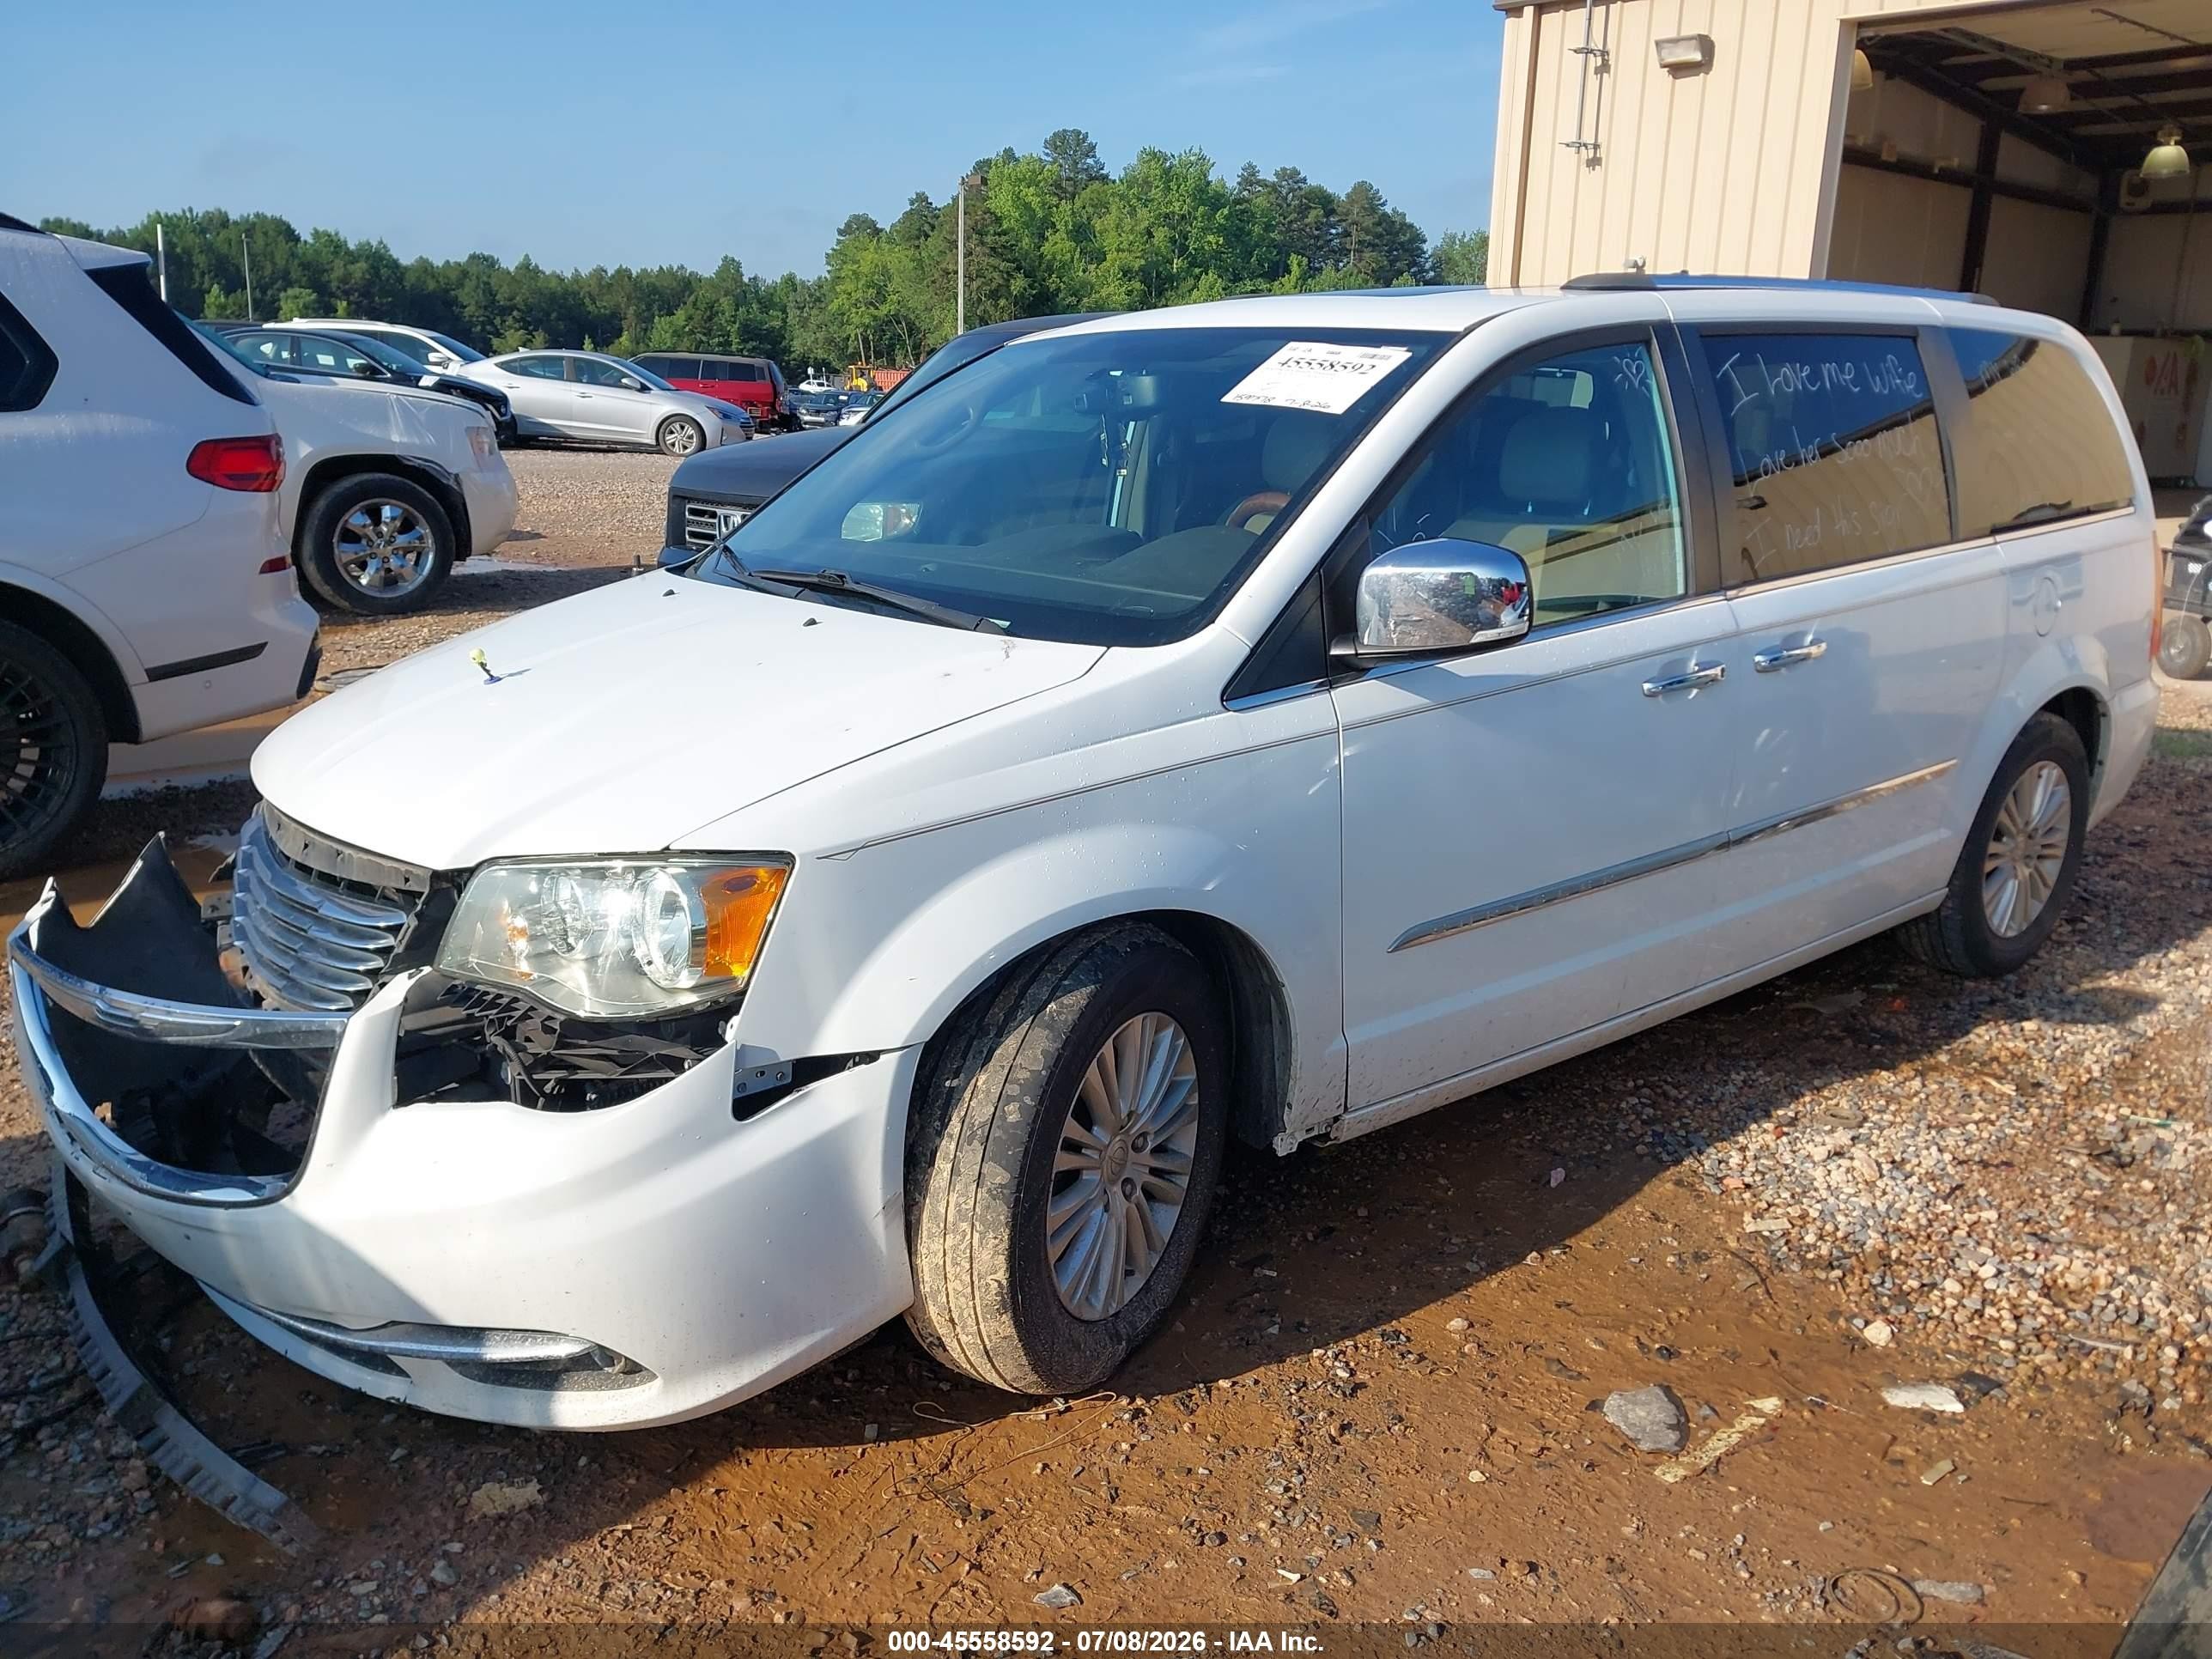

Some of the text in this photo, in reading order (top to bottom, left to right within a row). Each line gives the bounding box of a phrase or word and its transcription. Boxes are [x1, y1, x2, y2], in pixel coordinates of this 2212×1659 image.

[1278, 356, 1376, 374] 45558592
[1716, 352, 1759, 416] I
[1756, 352, 1821, 395] Love
